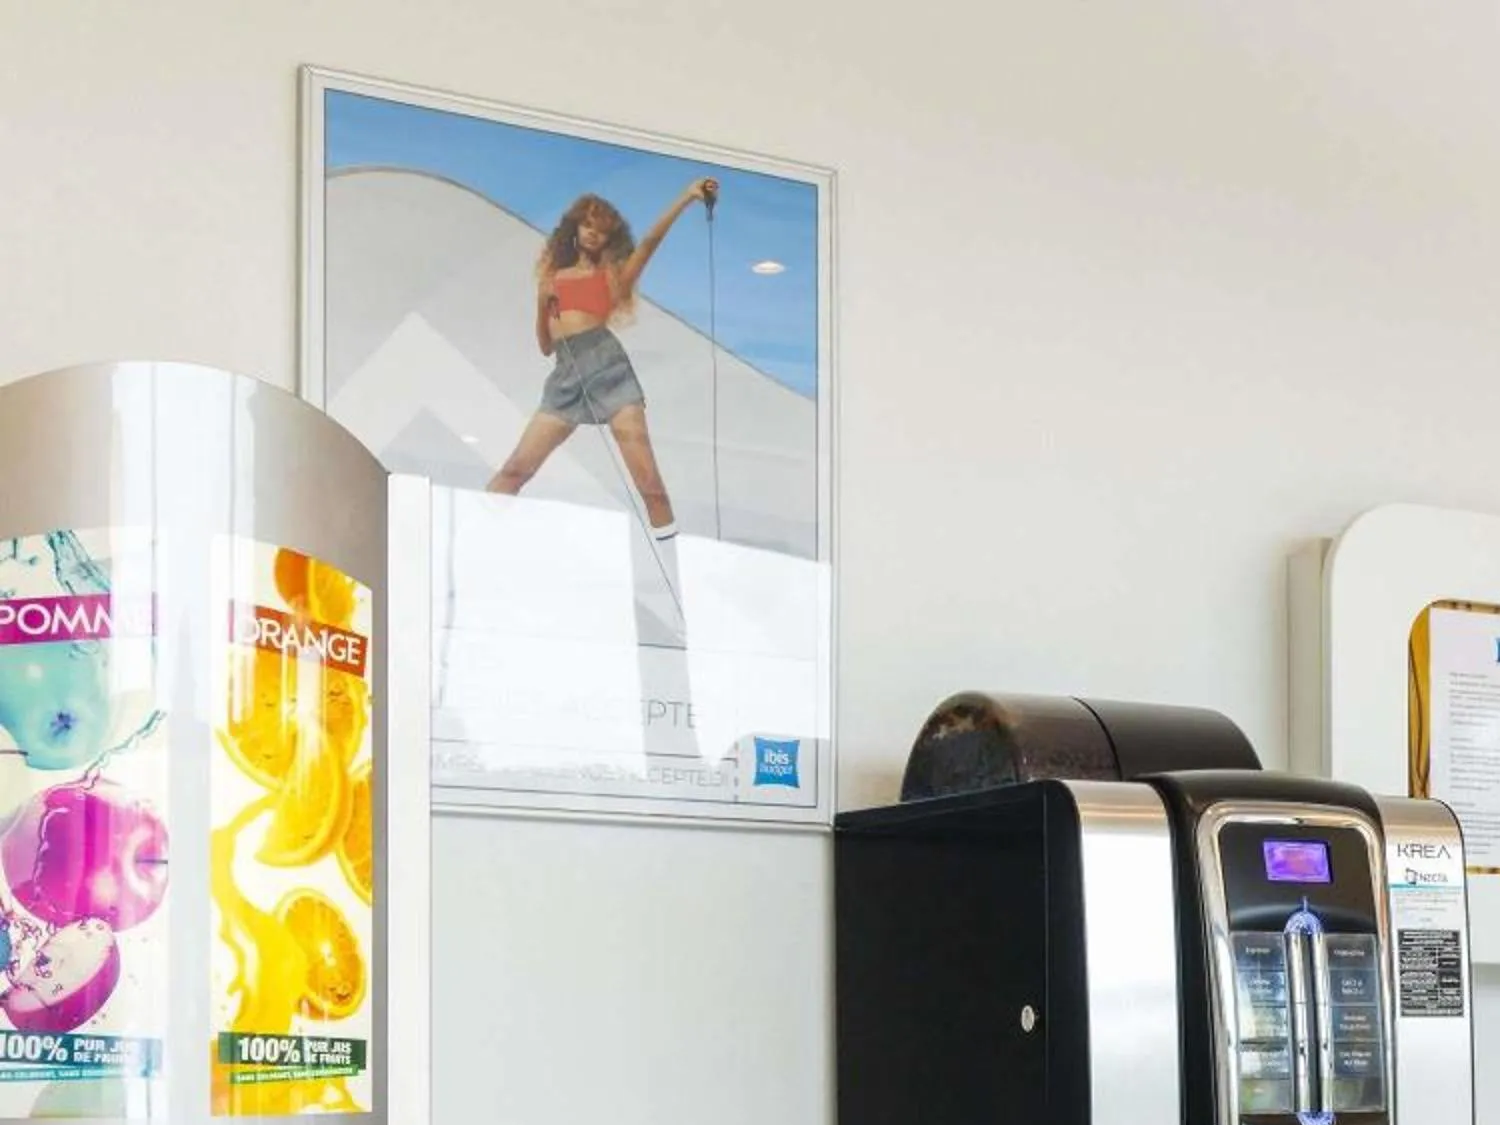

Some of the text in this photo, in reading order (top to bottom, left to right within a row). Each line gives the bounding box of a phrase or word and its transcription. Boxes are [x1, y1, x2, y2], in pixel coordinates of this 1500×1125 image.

[0, 602, 120, 637] POMM
[241, 616, 362, 666] ORANGE
[764, 748, 789, 765] ibis
[1397, 843, 1451, 859] KREA
[73, 1038, 106, 1051] PUR
[239, 1037, 301, 1063] 100%
[331, 1040, 352, 1054] JUS
